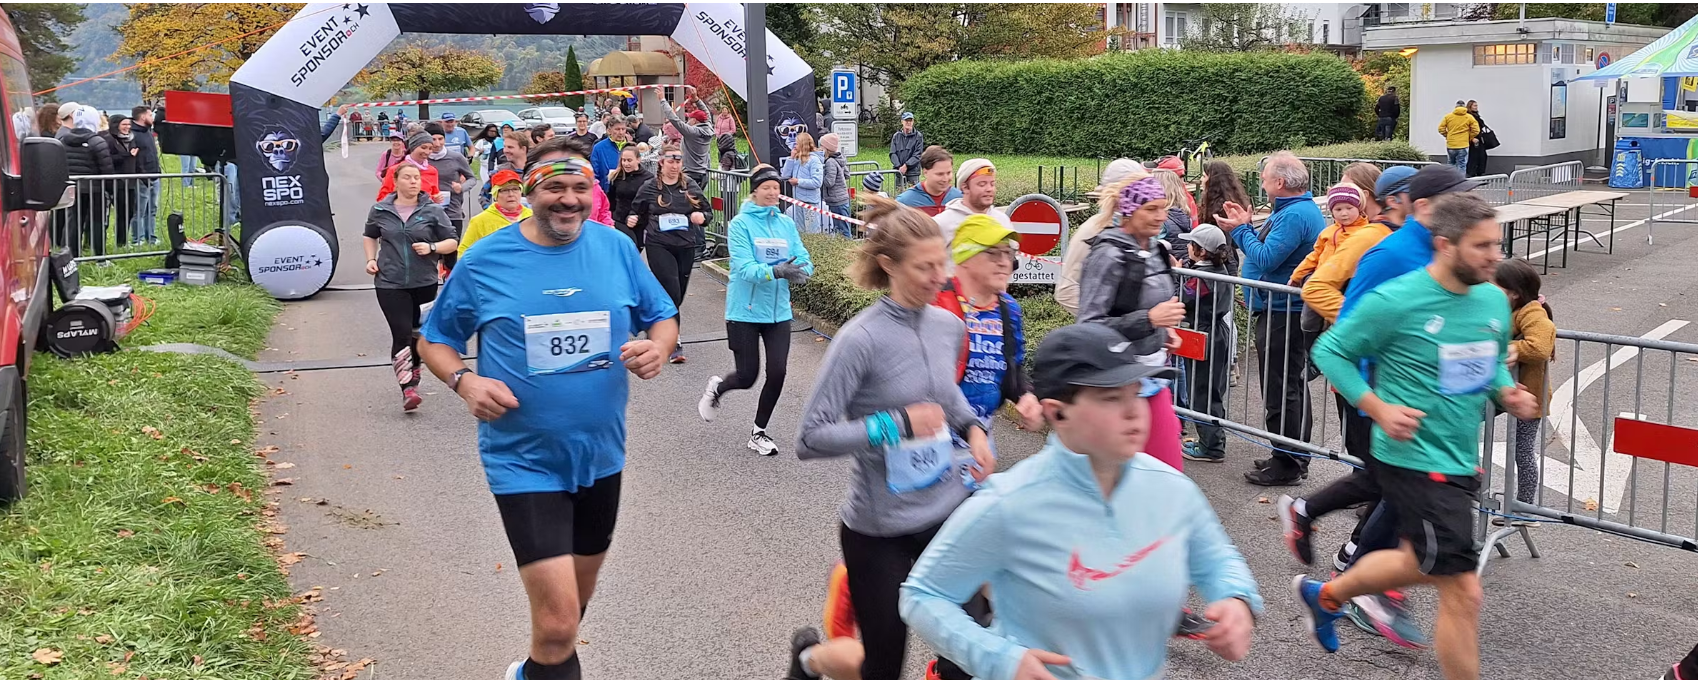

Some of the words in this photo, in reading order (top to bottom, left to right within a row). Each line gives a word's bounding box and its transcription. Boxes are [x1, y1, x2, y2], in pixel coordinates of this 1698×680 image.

[299, 16, 338, 57] EVENT
[724, 19, 746, 42] EVE
[837, 75, 848, 98] P
[264, 187, 303, 201] SPO
[274, 255, 304, 264] EVENT
[1013, 272, 1054, 281] gestattet
[57, 328, 98, 339] MYLAPS
[550, 334, 590, 356] 832
